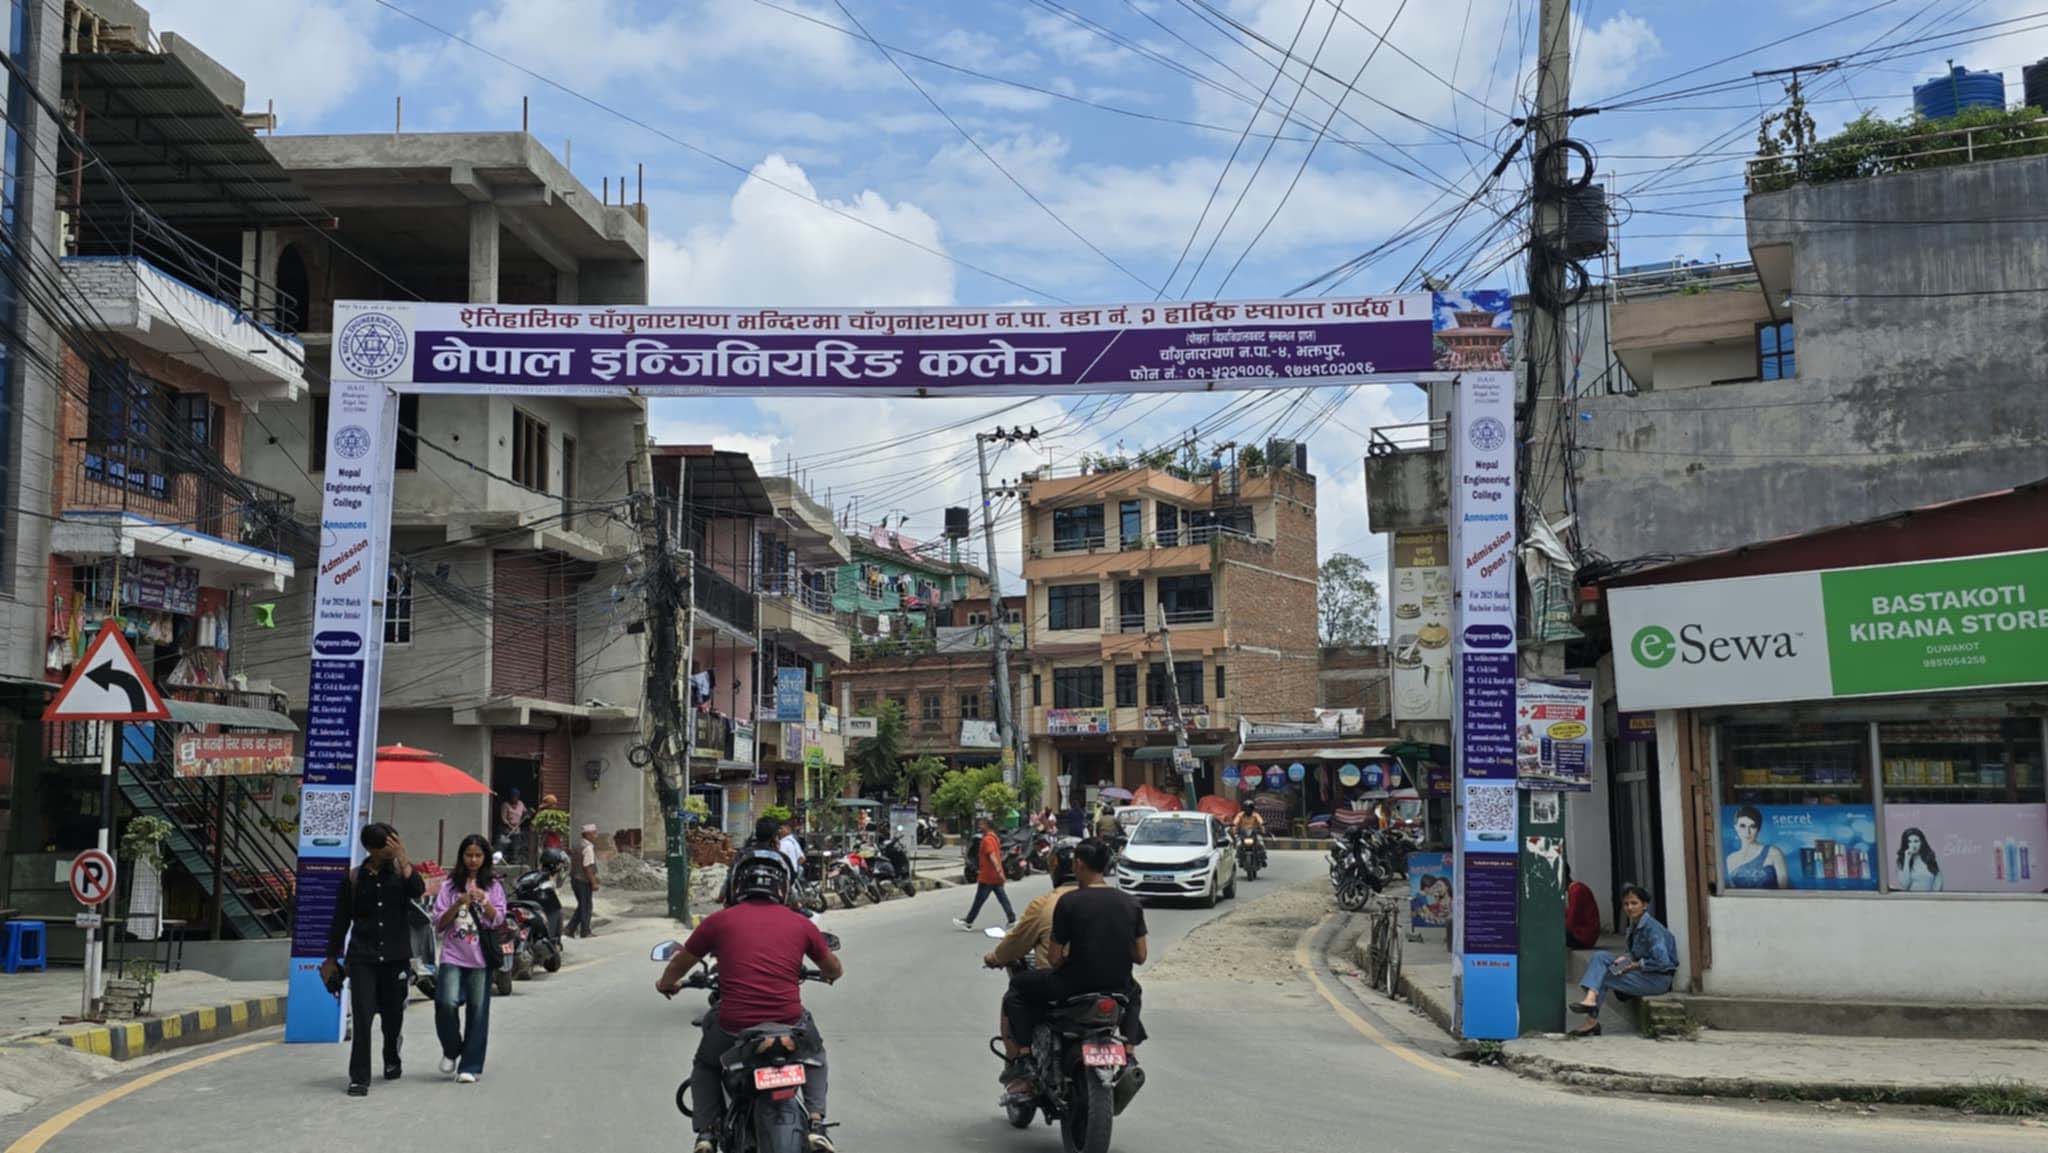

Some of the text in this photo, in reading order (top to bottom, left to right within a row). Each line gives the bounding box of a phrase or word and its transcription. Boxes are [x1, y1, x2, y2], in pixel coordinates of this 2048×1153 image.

[460, 307, 579, 329] ऐतिहासिक
[588, 308, 730, 335] चाँगुनारायण
[737, 310, 842, 331] मन्दिरमा
[849, 310, 988, 336] चाँगुनारायण
[995, 311, 1050, 329] न.पा.
[1059, 309, 1100, 328] वडा
[1108, 305, 1132, 325] नं.
[1164, 301, 1238, 324] हार्दिक
[1244, 302, 1326, 320] स्वागत
[1332, 298, 1392, 318] गर्दछ
[431, 336, 1067, 381] नेपाल इन्जिनियरिङ कलेज
[1160, 344, 1234, 366] चाँगुनारायण
[1296, 343, 1346, 361] भक्तपुर,
[1129, 364, 1160, 380] फोन
[338, 467, 361, 479] Nepal
[1475, 460, 1498, 471] Nepal
[1463, 475, 1510, 487] Engineering
[326, 482, 372, 497] Engineering
[1472, 490, 1502, 501] College
[332, 497, 362, 510] College
[323, 519, 367, 530] Announces
[1463, 512, 1508, 523] Announces
[320, 538, 369, 577] Admission
[1465, 530, 1512, 569] Admission
[334, 561, 362, 586] Open!
[1480, 553, 1507, 579] Open!
[1872, 584, 2026, 615] BASTAKOTI
[1849, 608, 2048, 642] KIRANA STORE
[1926, 641, 1980, 654] DUWAKOT
[1772, 811, 1812, 825] secret
[82, 861, 103, 893] P
